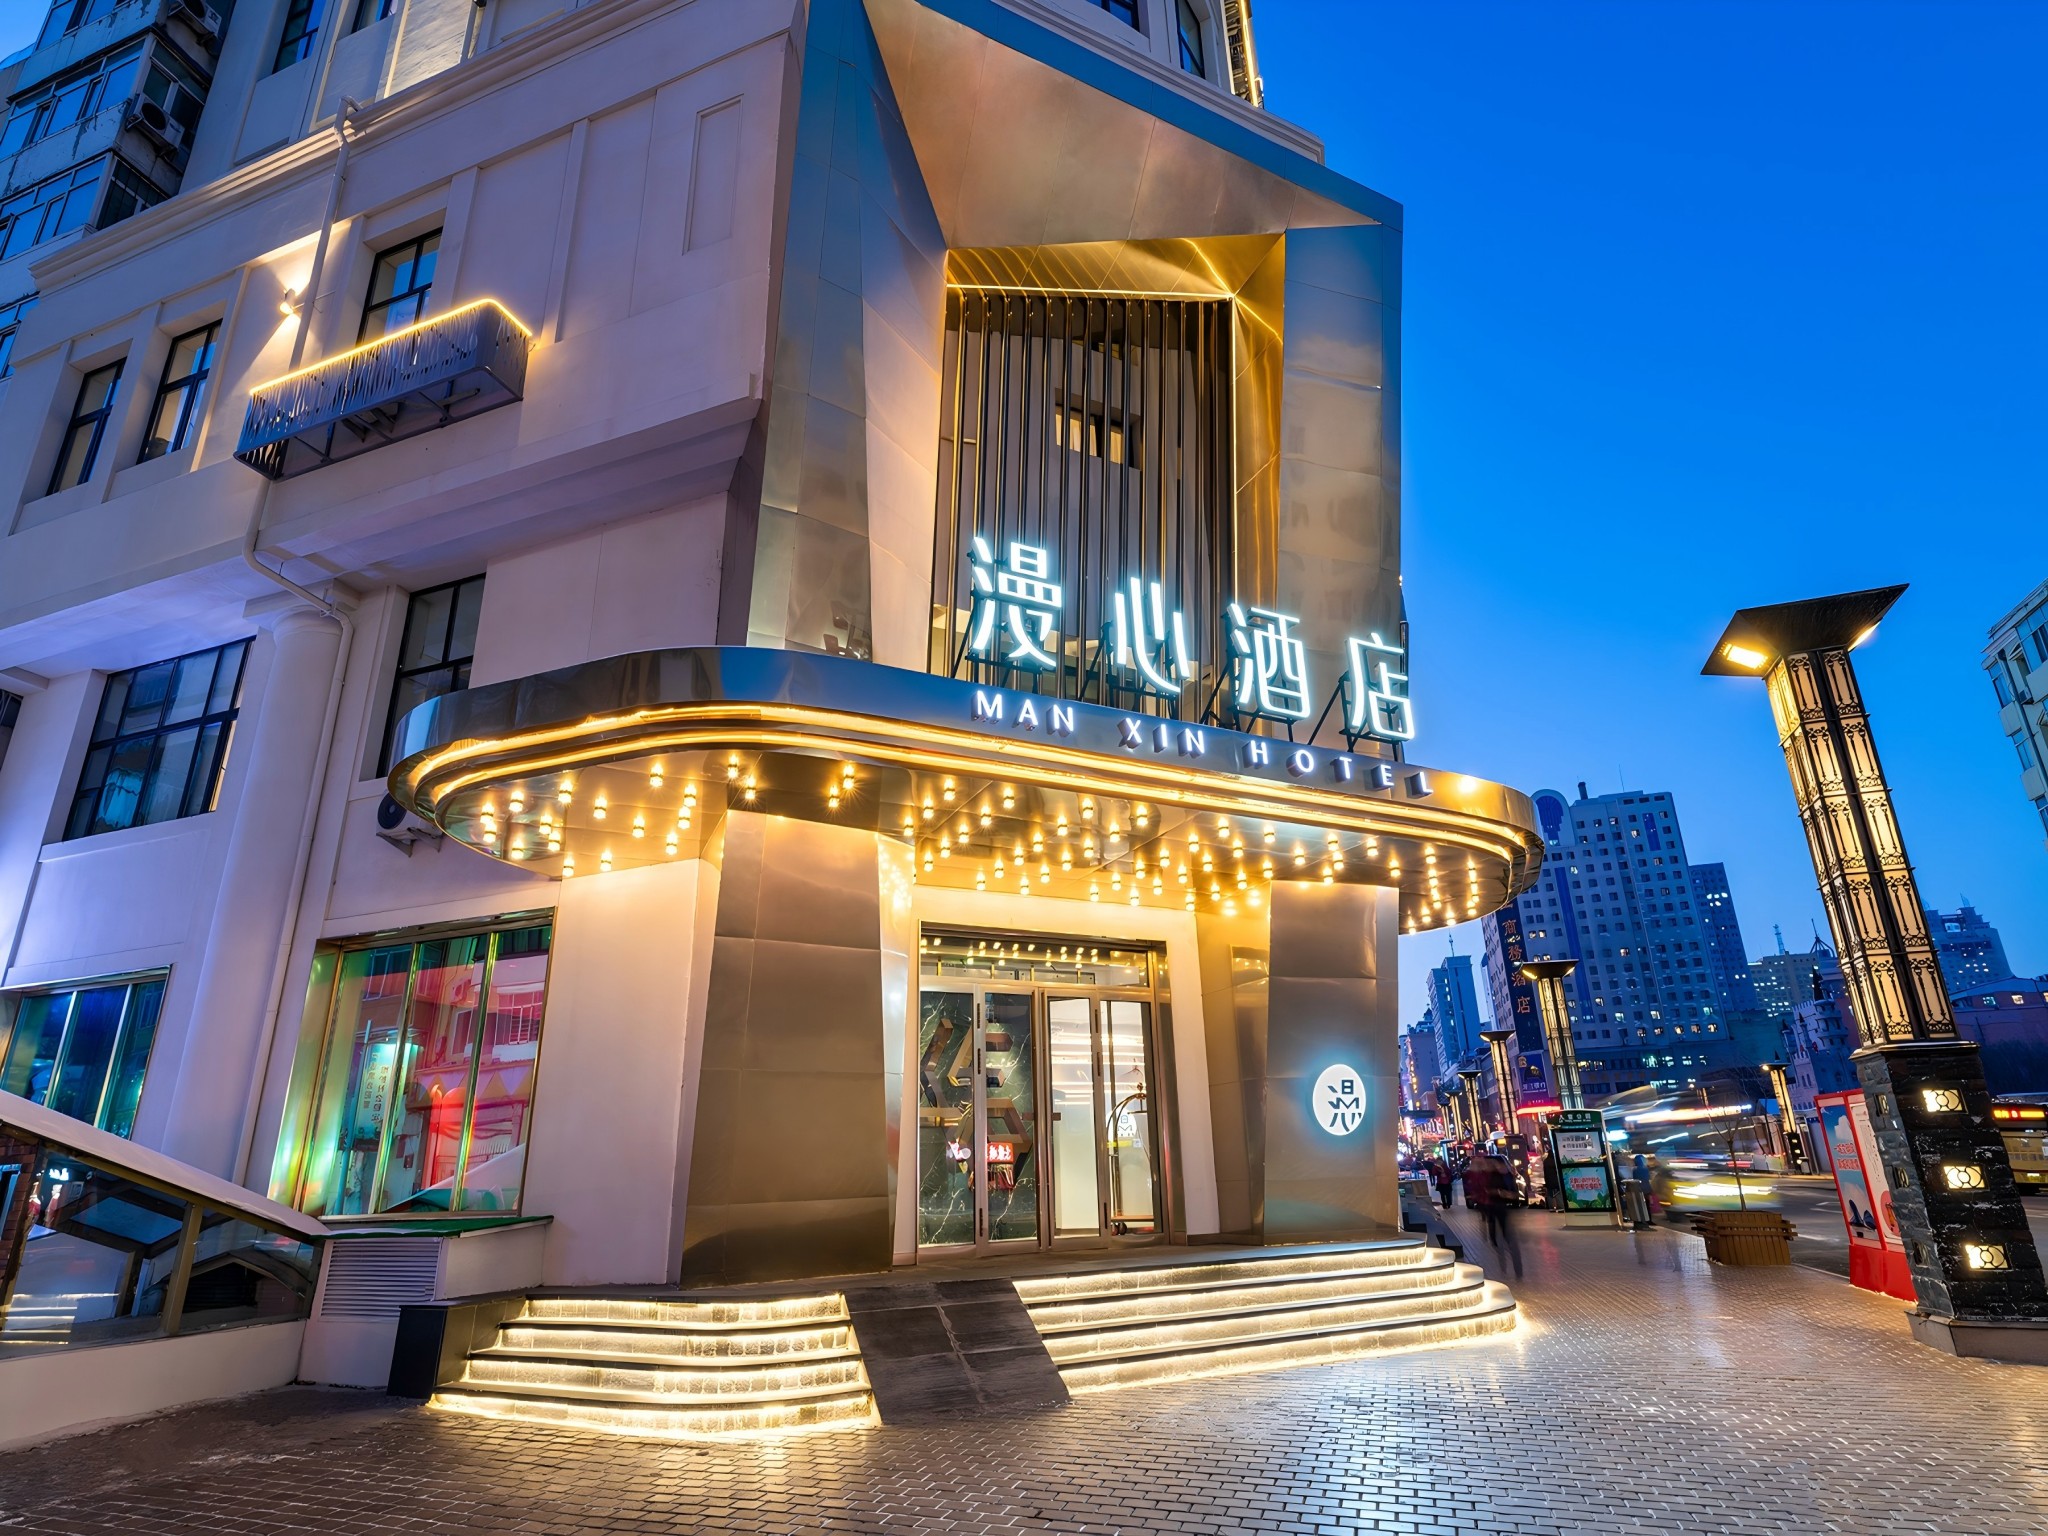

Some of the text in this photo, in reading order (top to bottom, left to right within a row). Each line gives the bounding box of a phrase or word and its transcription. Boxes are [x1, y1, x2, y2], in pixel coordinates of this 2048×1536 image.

[972, 536, 1415, 740] 漫心酒店
[973, 690, 1434, 796] MAN XIN HOTEL
[1500, 902, 1531, 1013] 商務酒店
